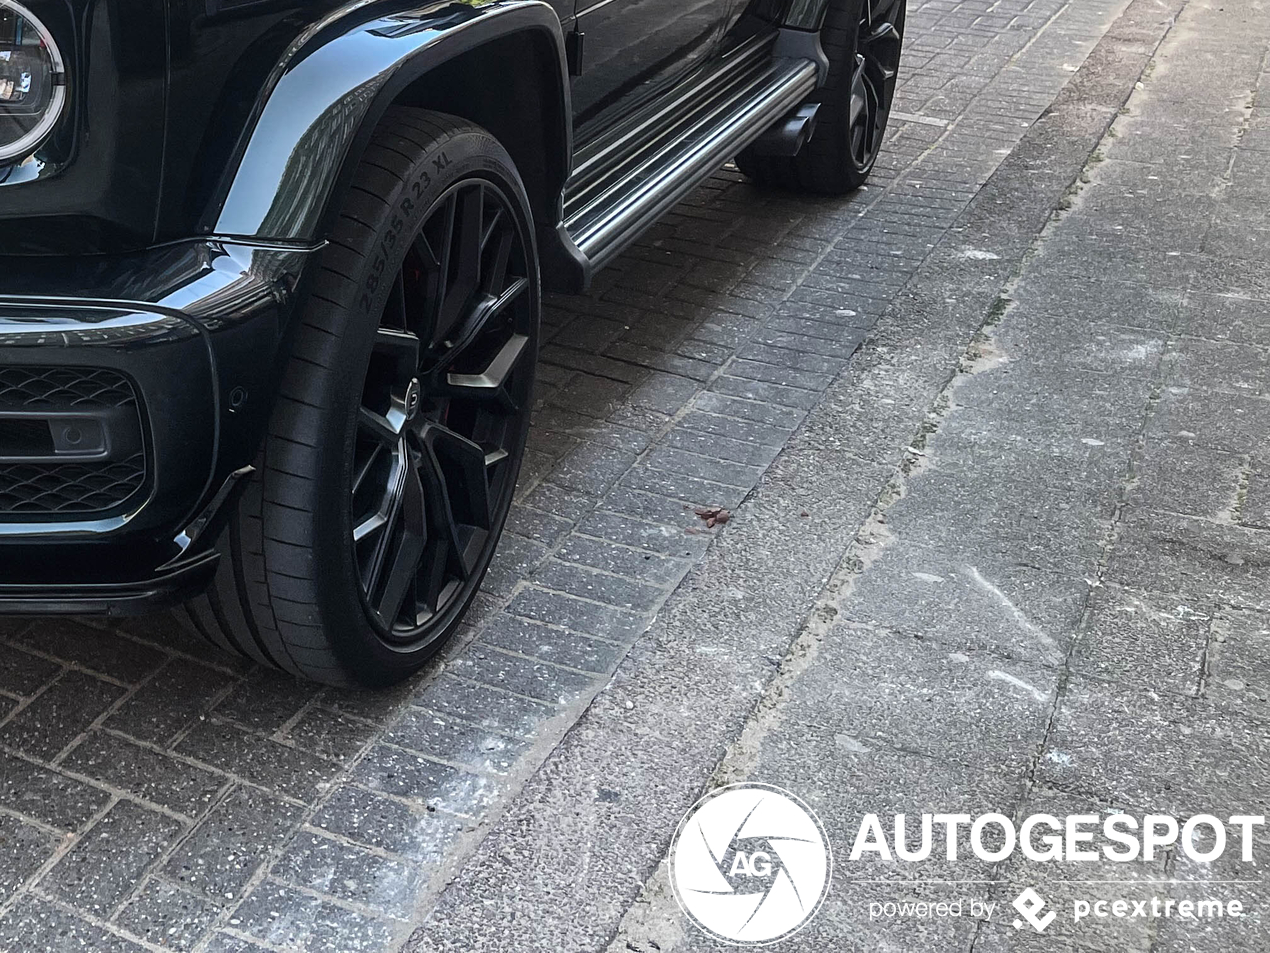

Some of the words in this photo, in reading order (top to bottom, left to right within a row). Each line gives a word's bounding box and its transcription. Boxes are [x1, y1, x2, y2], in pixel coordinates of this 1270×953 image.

[358, 214, 404, 315] 285/35
[400, 197, 414, 218] R
[412, 171, 431, 199] 23
[432, 151, 453, 175] XL
